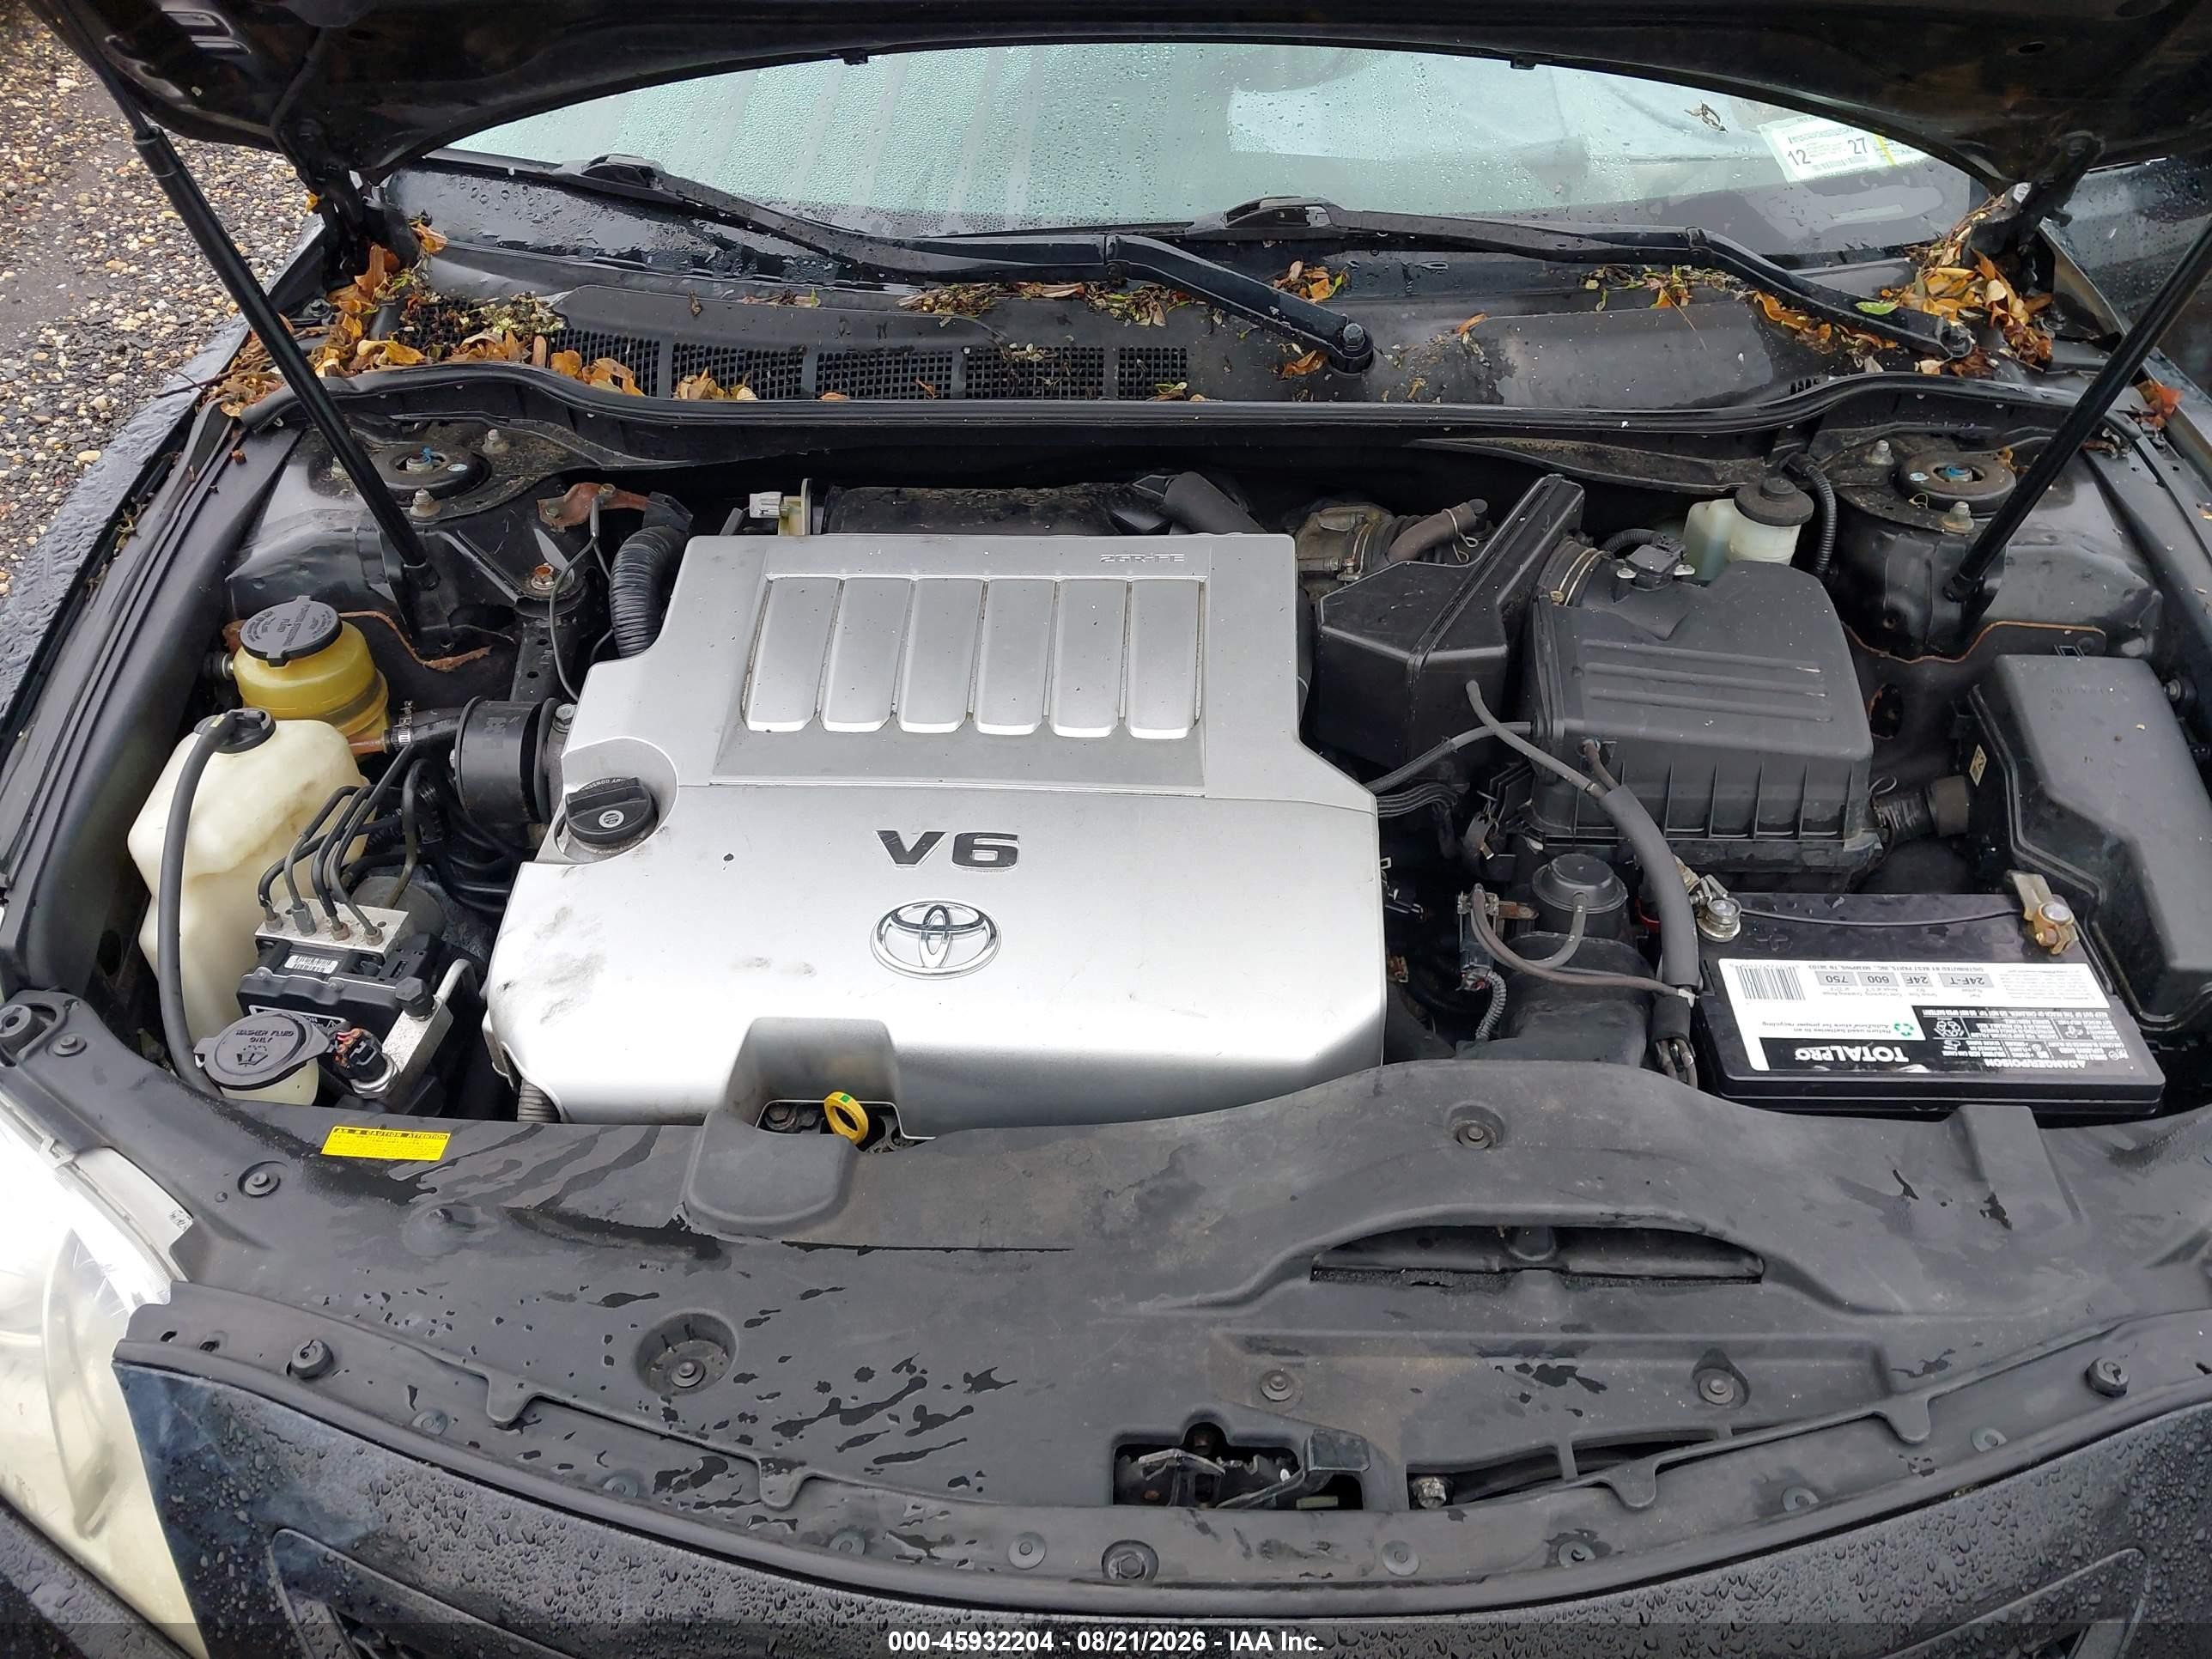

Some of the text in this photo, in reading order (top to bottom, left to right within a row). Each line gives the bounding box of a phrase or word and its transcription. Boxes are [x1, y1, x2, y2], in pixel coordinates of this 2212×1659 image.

[1787, 149, 1811, 167] 12
[1847, 137, 1869, 155] 27
[875, 830, 1019, 870] V6
[1826, 975, 1848, 983] 750
[1867, 975, 1889, 984] 600
[1906, 975, 1928, 984] 24F
[1949, 976, 1985, 985] 24F-T
